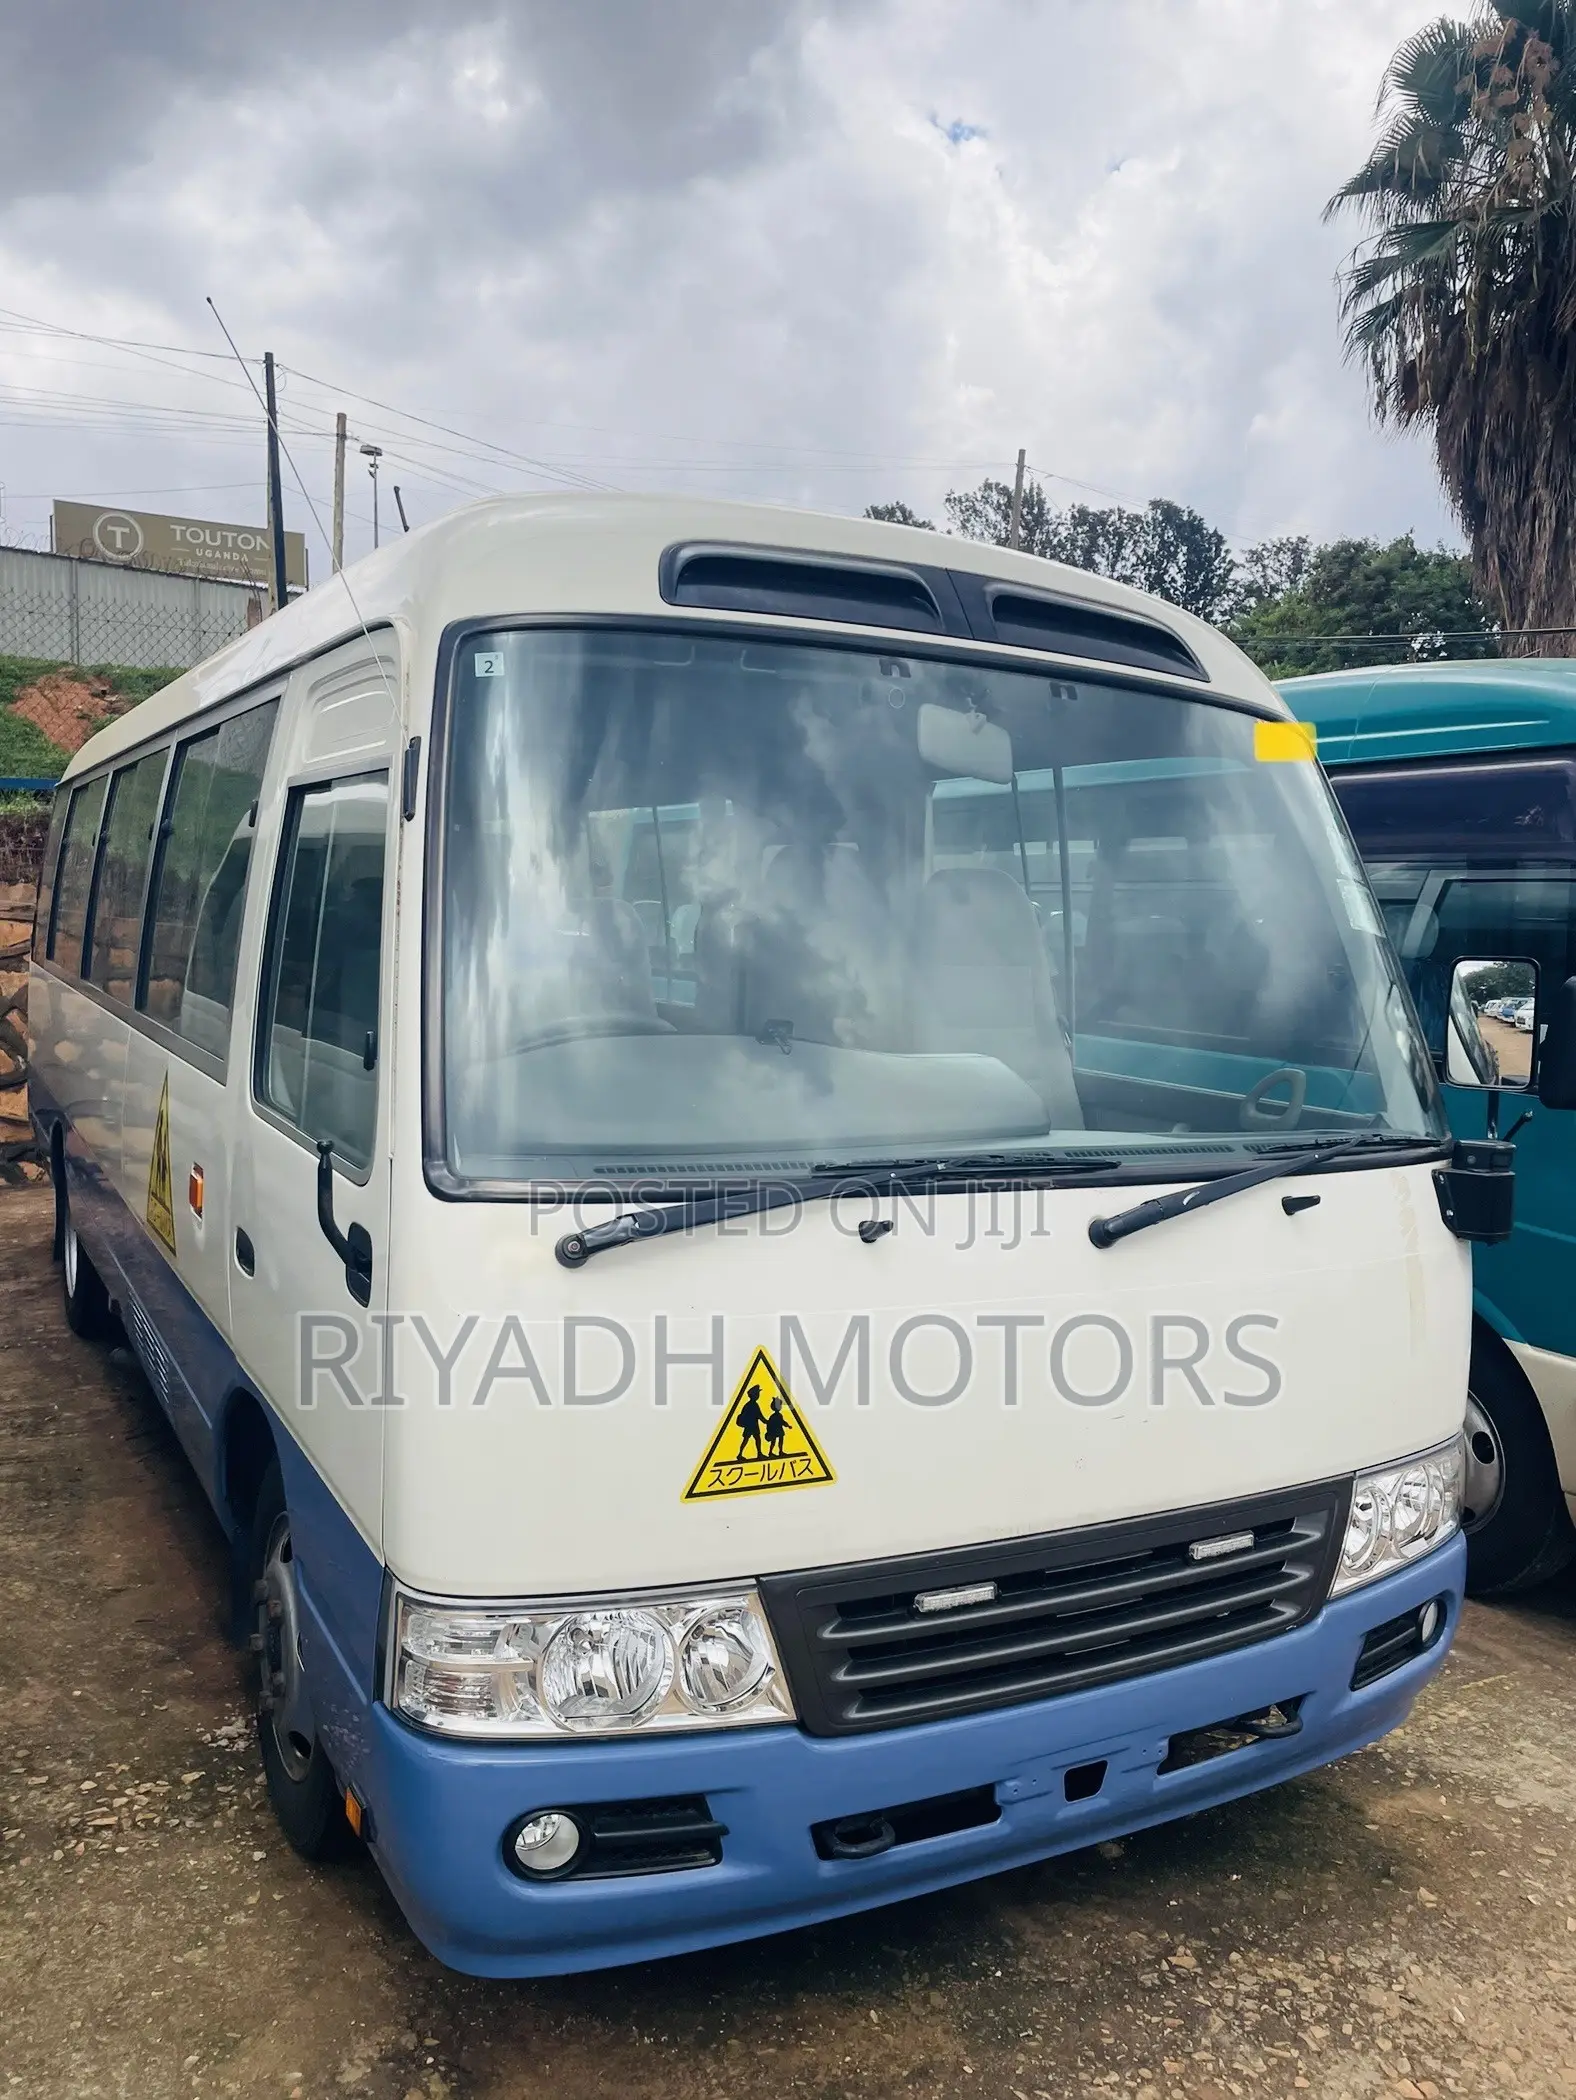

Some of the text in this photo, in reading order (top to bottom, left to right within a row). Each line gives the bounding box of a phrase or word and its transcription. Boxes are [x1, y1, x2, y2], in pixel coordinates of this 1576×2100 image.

[107, 525, 130, 548] T
[195, 548, 248, 562] UGANDA
[484, 660, 494, 674] 2
[707, 1458, 814, 1488] スクールバス
